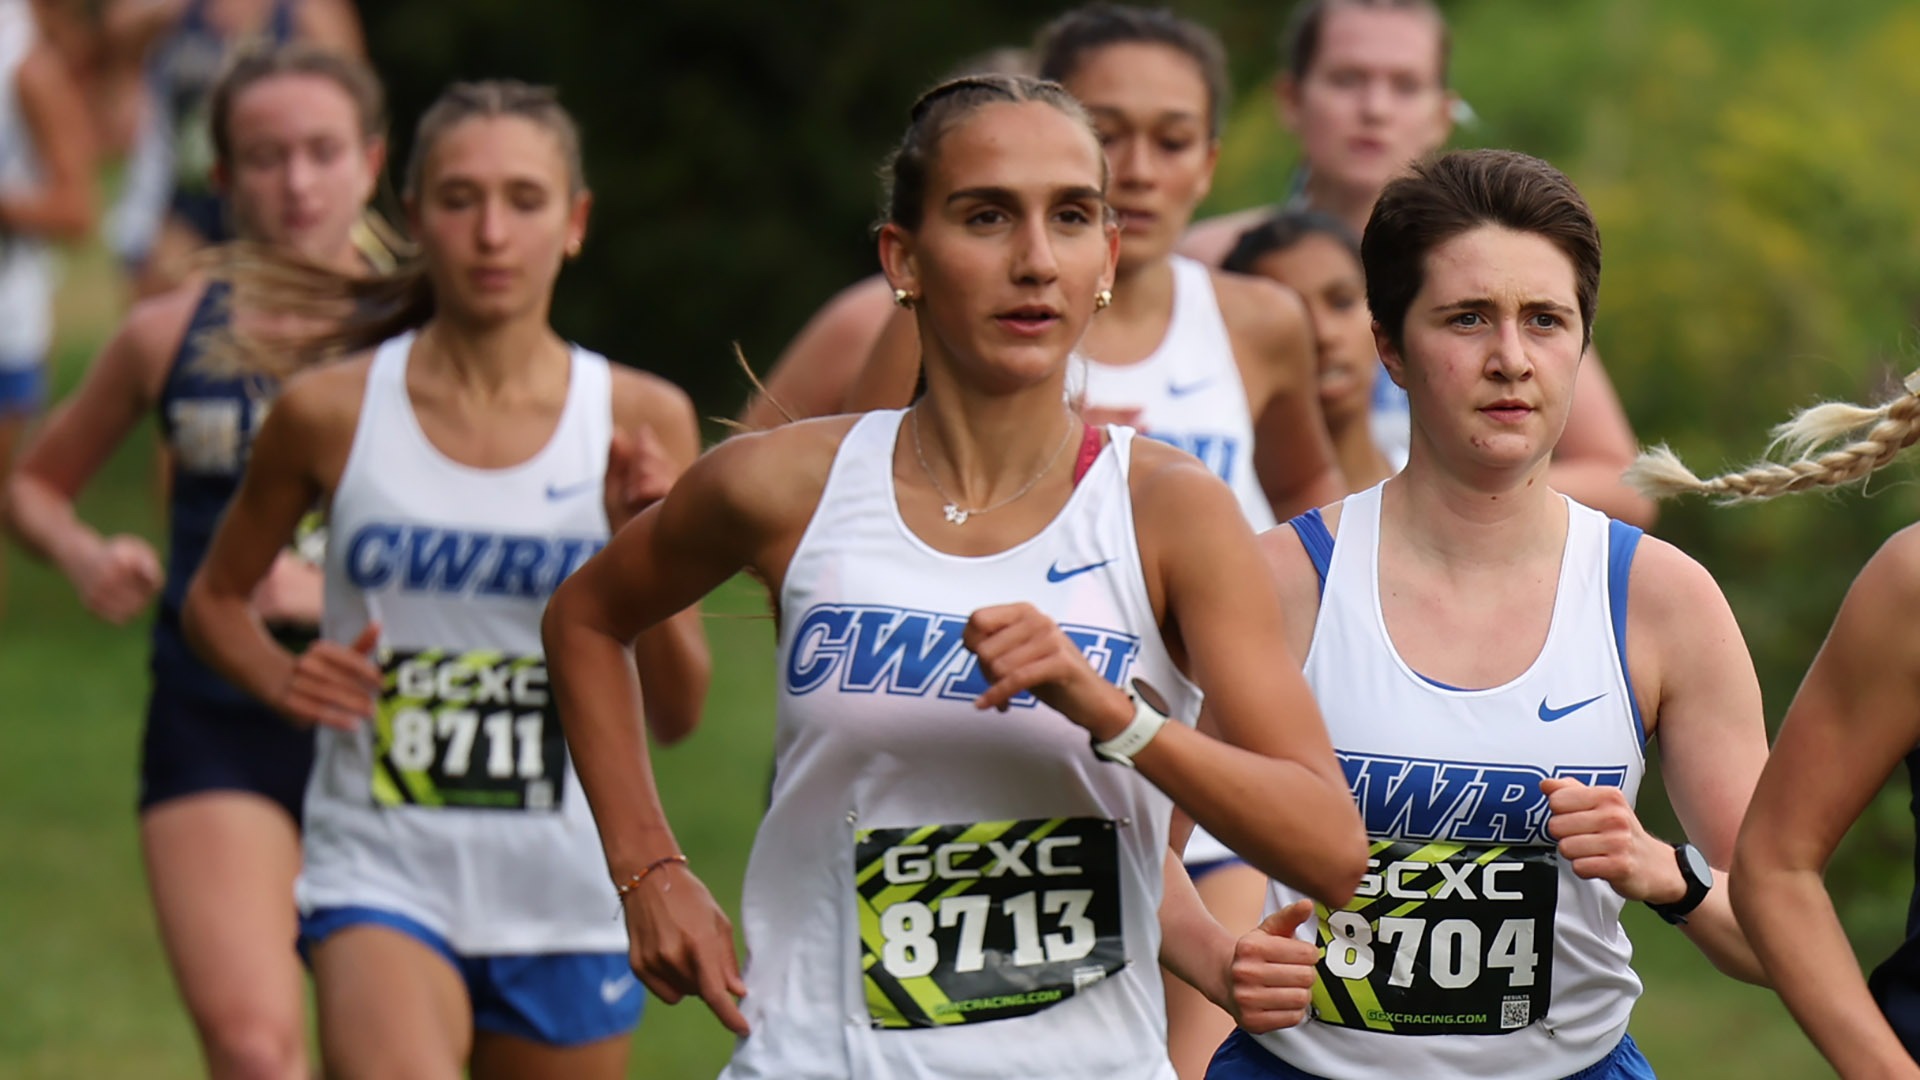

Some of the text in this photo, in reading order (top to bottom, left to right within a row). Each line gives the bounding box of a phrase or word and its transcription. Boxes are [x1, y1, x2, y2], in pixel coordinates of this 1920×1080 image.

[396, 658, 549, 705] GCXC
[390, 708, 544, 778] 8711
[1333, 747, 1629, 845] WR
[883, 835, 1083, 885] GCXC
[880, 889, 1097, 979] 8713
[1325, 910, 1539, 989] 8704
